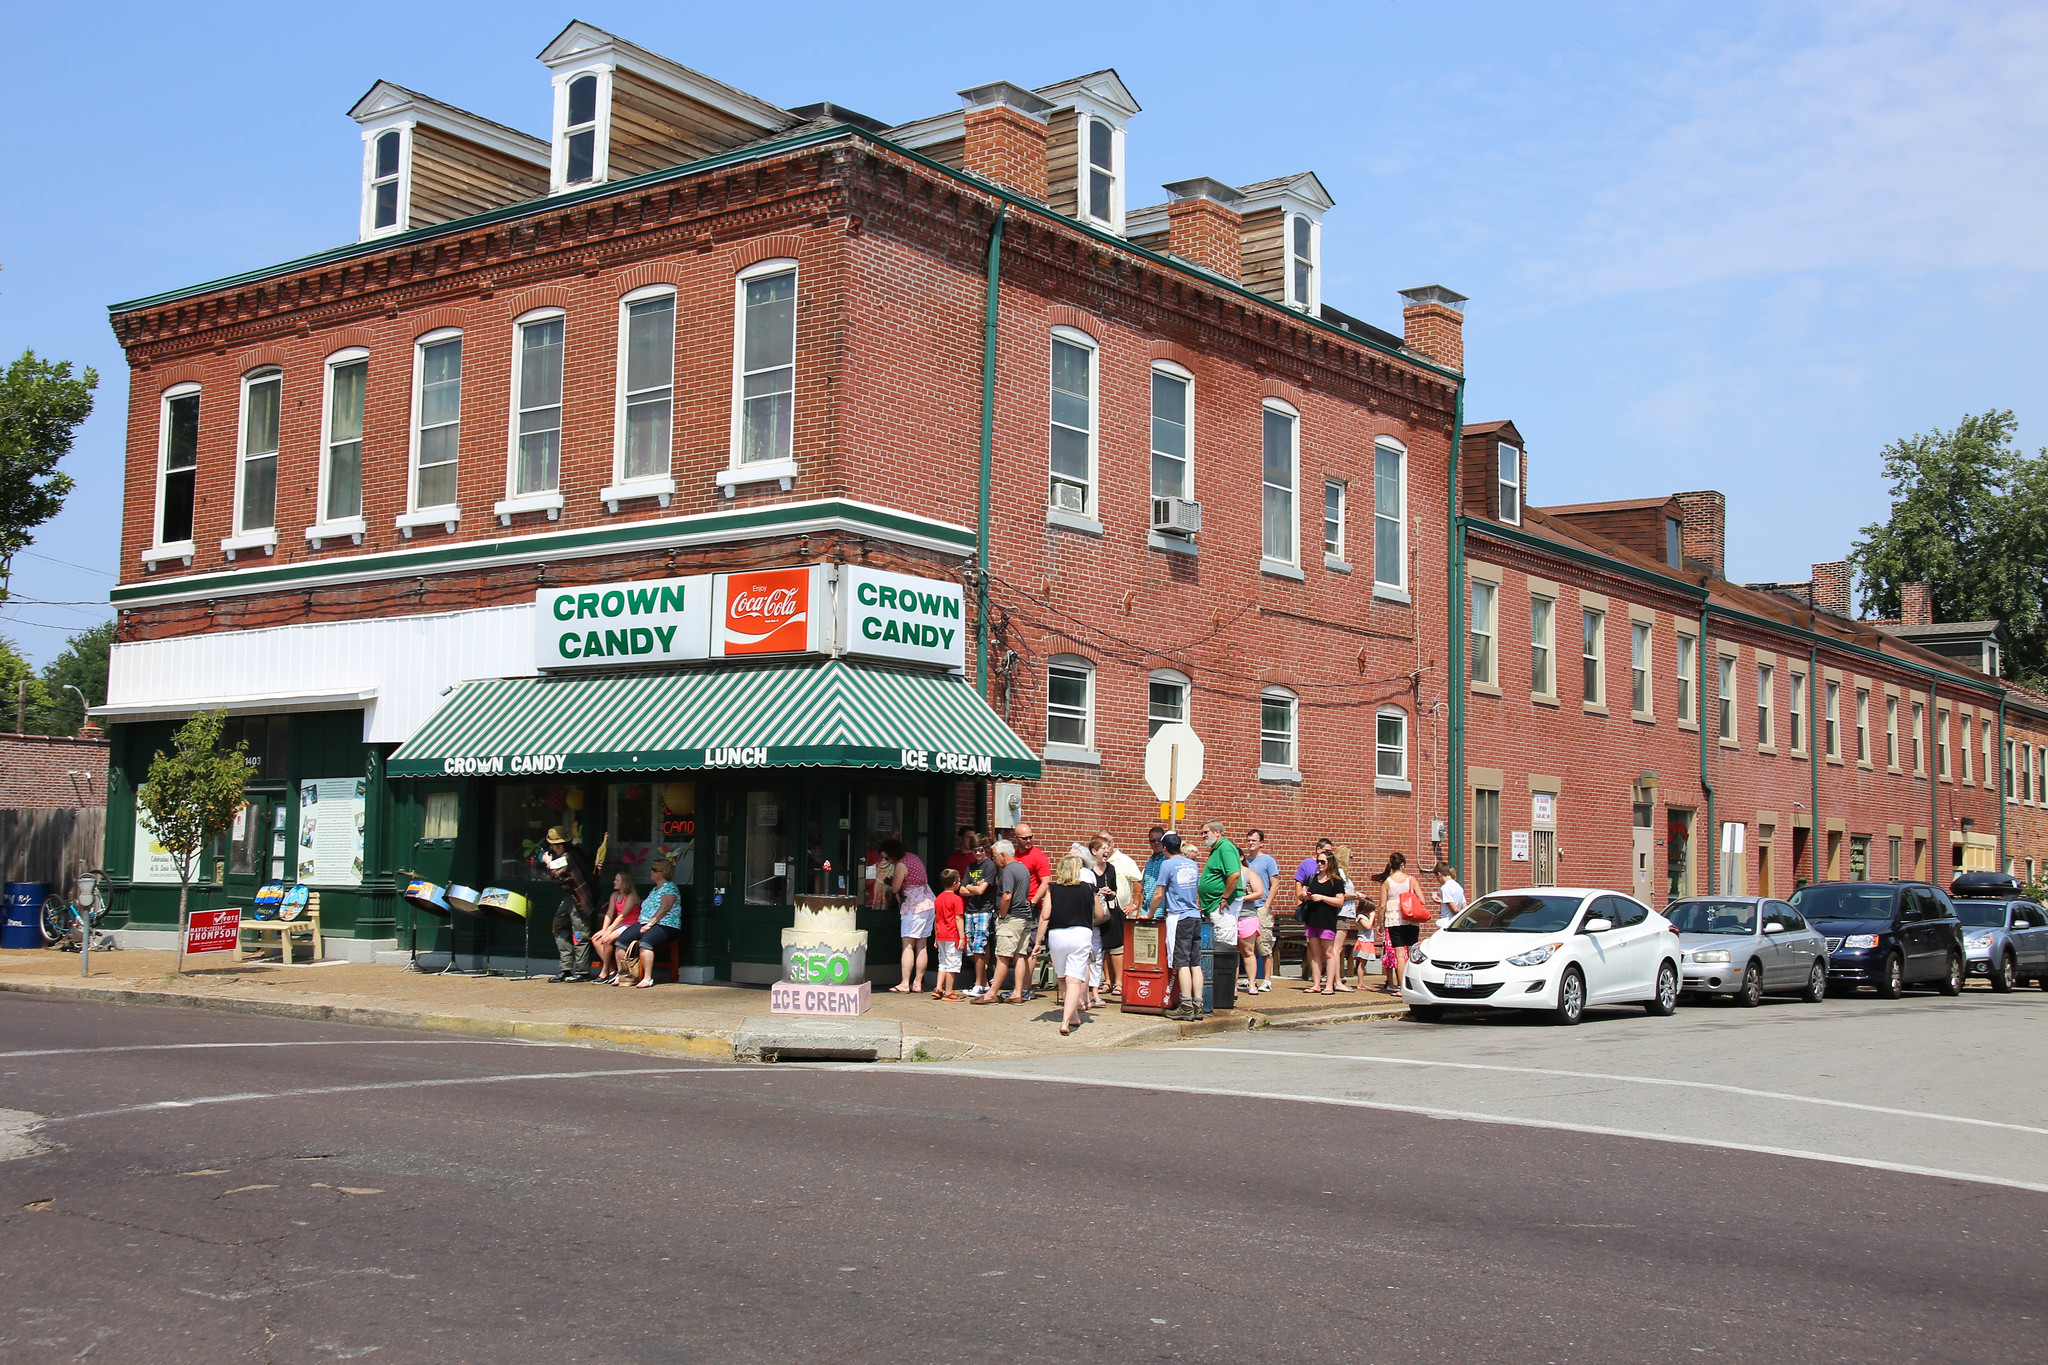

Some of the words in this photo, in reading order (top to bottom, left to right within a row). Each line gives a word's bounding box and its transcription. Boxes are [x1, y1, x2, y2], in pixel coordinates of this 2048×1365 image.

[752, 585, 768, 593] Enjoy
[857, 582, 959, 620] CROWN
[553, 585, 686, 621] CROWN
[730, 587, 800, 619] Coca-Cola
[558, 625, 678, 659] CANDY
[861, 616, 955, 650] CANDY
[444, 757, 504, 774] CROWN
[510, 754, 567, 772] CANDY
[704, 747, 768, 766] LUNCH
[901, 749, 929, 768] ICE
[935, 752, 992, 773] CREAM
[663, 821, 695, 834] CAND
[223, 914, 239, 922] VOTE
[189, 929, 237, 942] THOMPSON
[772, 989, 800, 1010] ICE
[805, 990, 858, 1014] CREAM
